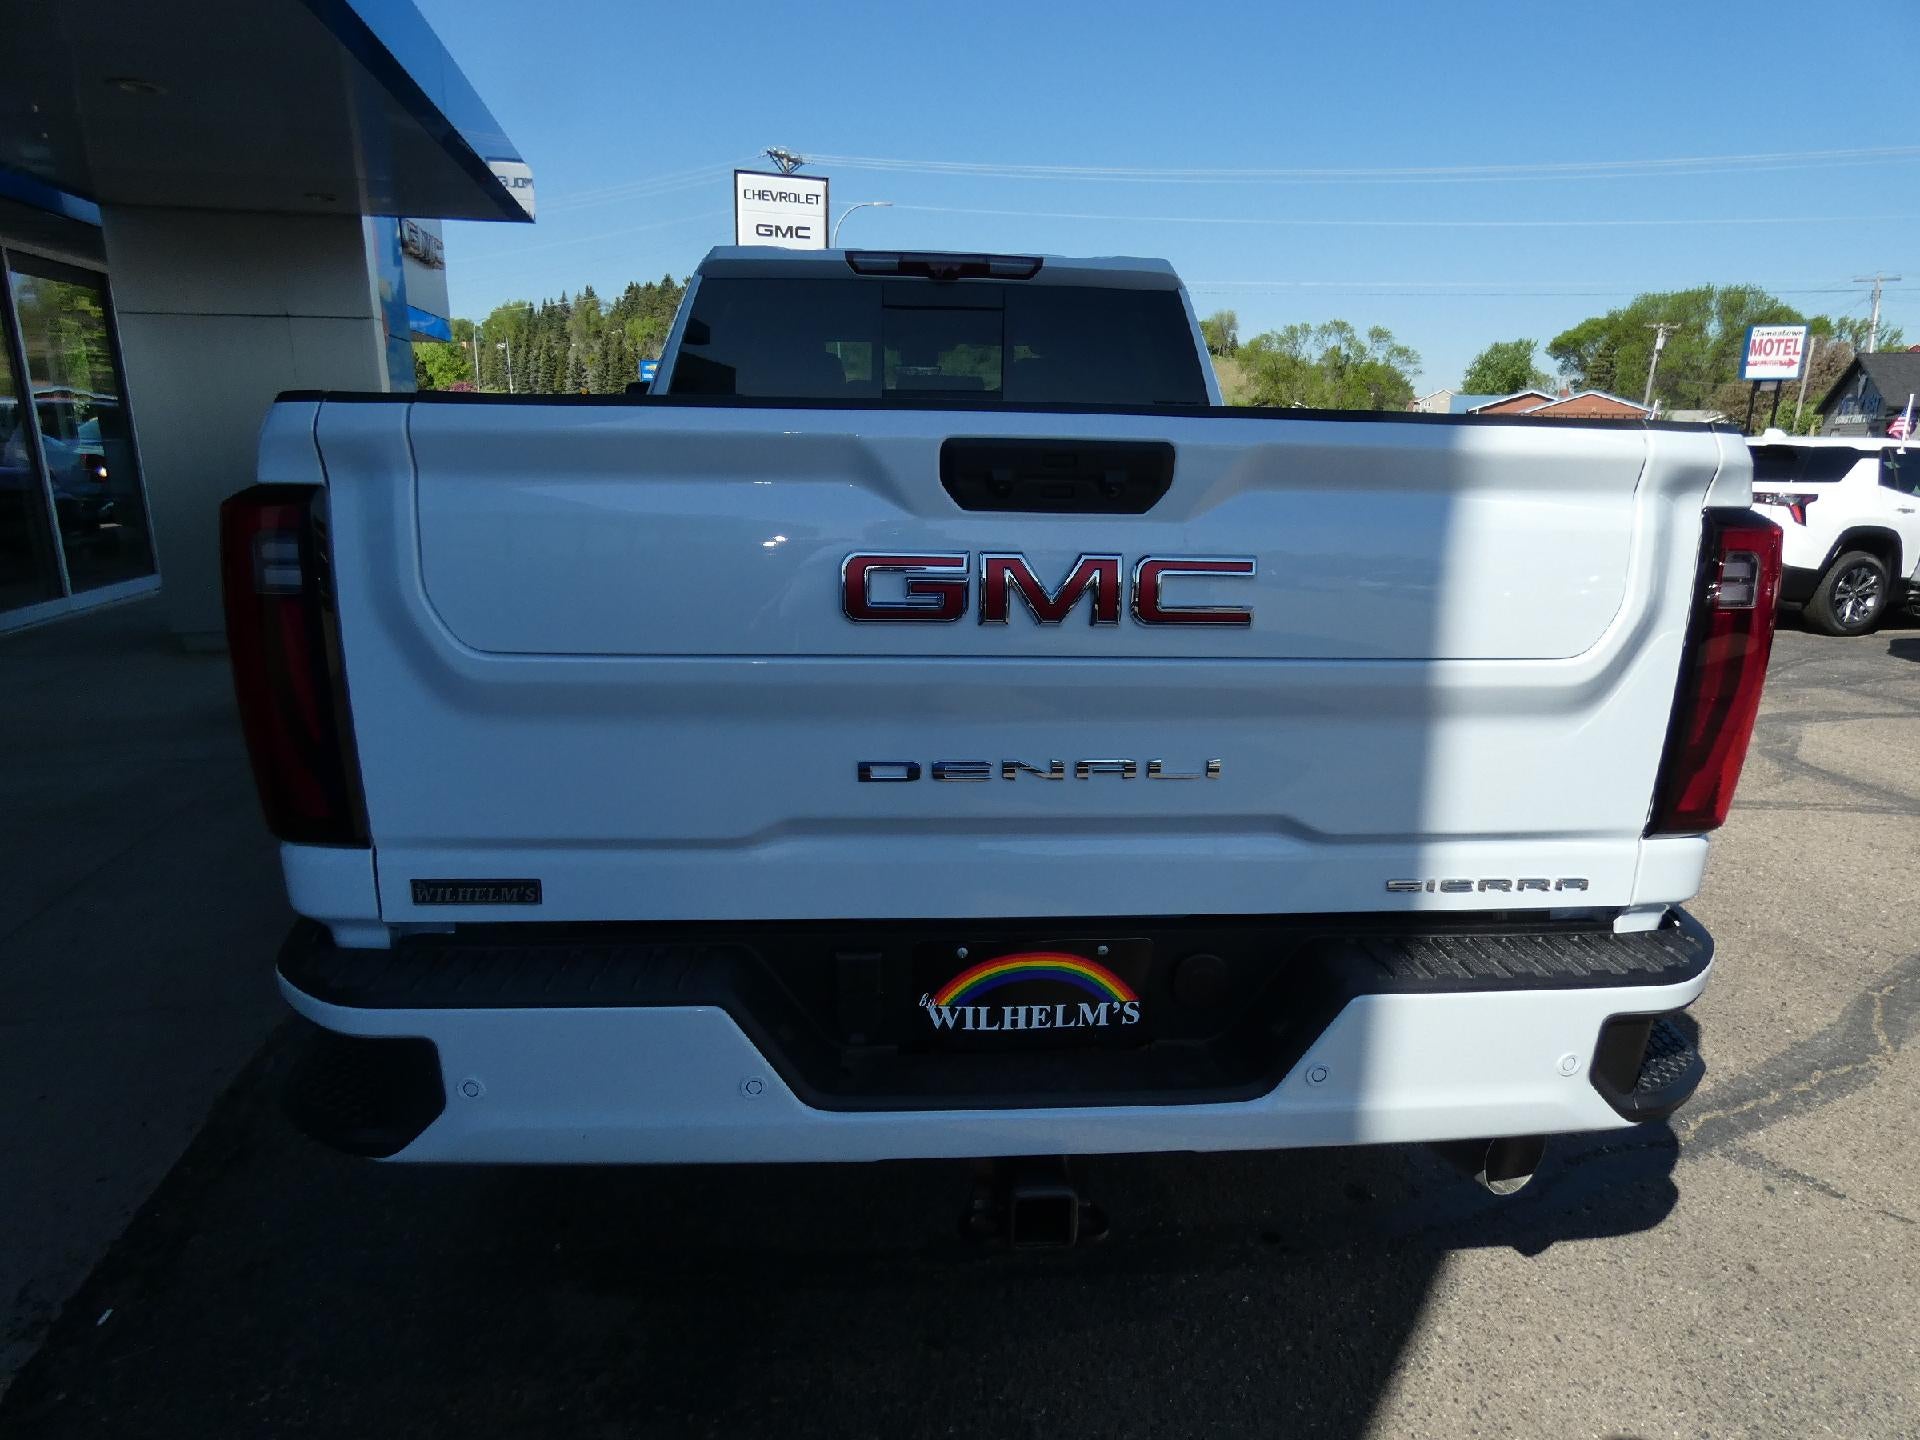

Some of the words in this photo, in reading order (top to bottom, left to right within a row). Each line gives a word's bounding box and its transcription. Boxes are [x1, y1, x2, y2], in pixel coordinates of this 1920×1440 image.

[743, 188, 821, 205] CHEVROLET
[755, 223, 811, 239] GMC
[1749, 338, 1801, 356] MOTEL
[840, 551, 1257, 628] GMC
[857, 758, 1221, 783] DENALI
[1386, 878, 1589, 893] SIERRA
[415, 887, 537, 902] WILHELM'S
[926, 1000, 1141, 1030] WILHELM'S
